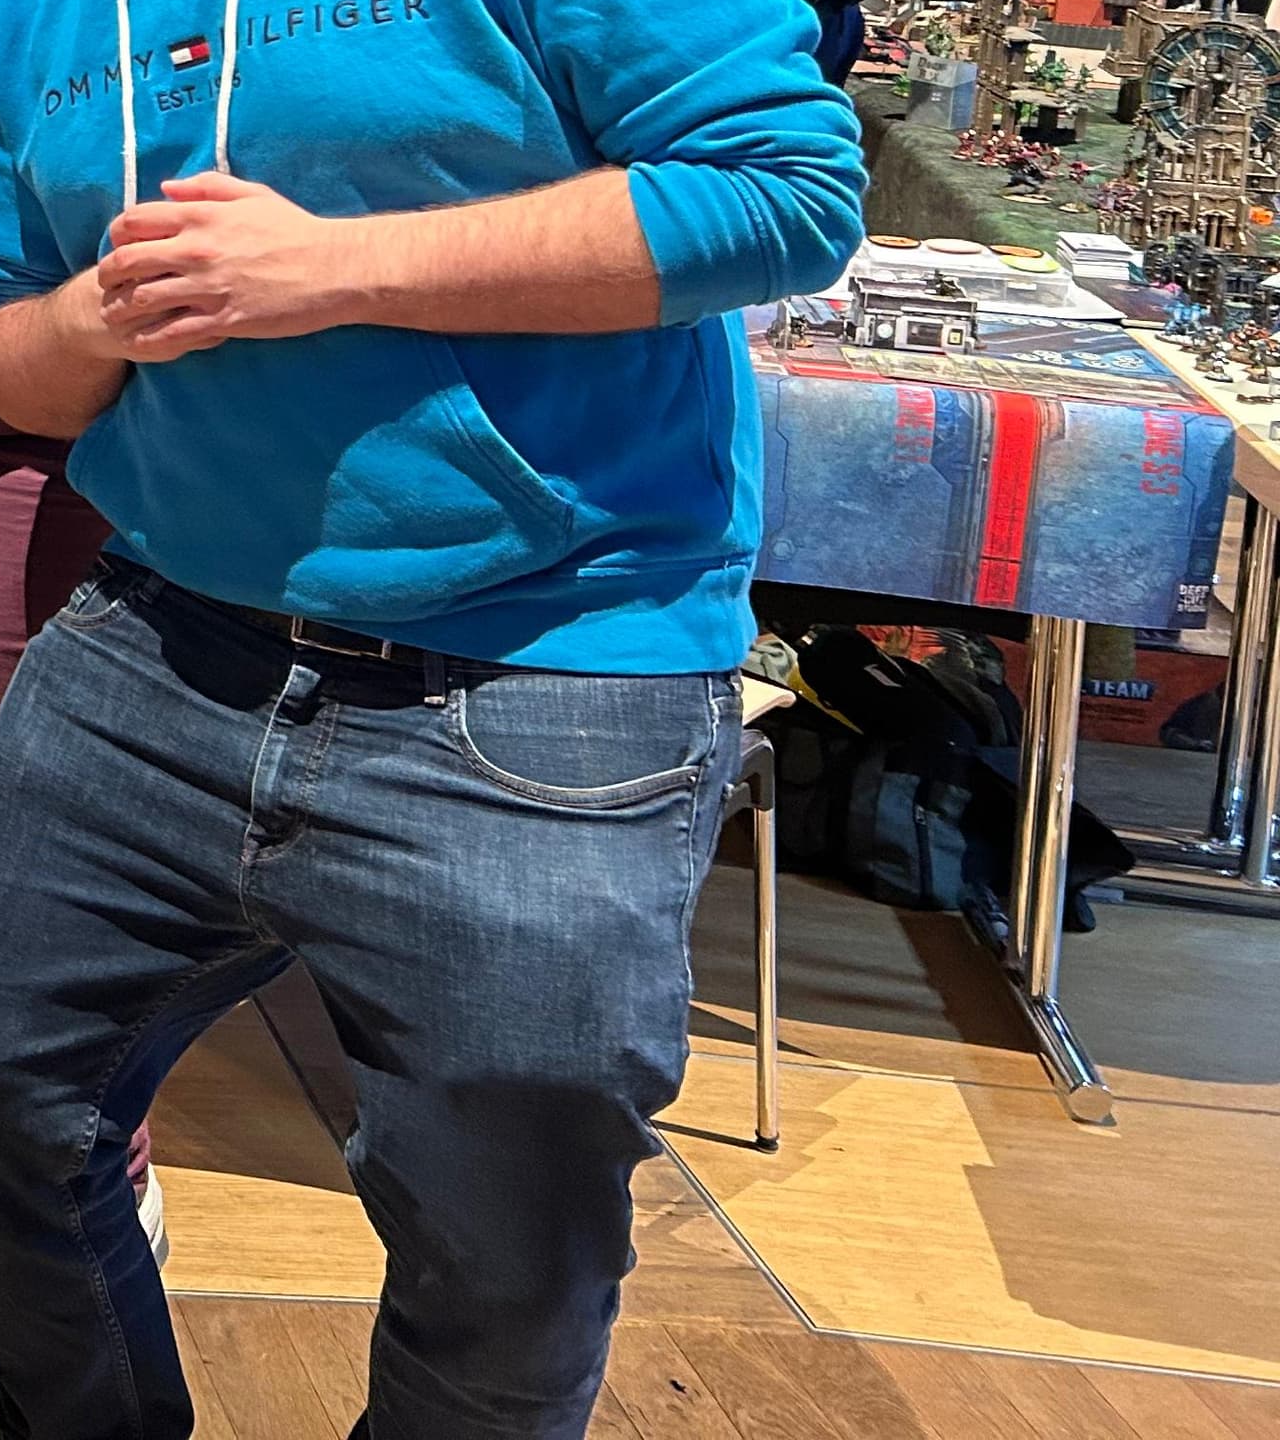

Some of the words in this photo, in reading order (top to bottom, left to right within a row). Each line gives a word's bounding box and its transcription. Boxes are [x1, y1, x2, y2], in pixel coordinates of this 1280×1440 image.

[45, 49, 154, 116] OMMY
[156, 83, 202, 112] EST.
[1091, 679, 1149, 699] TEAM
